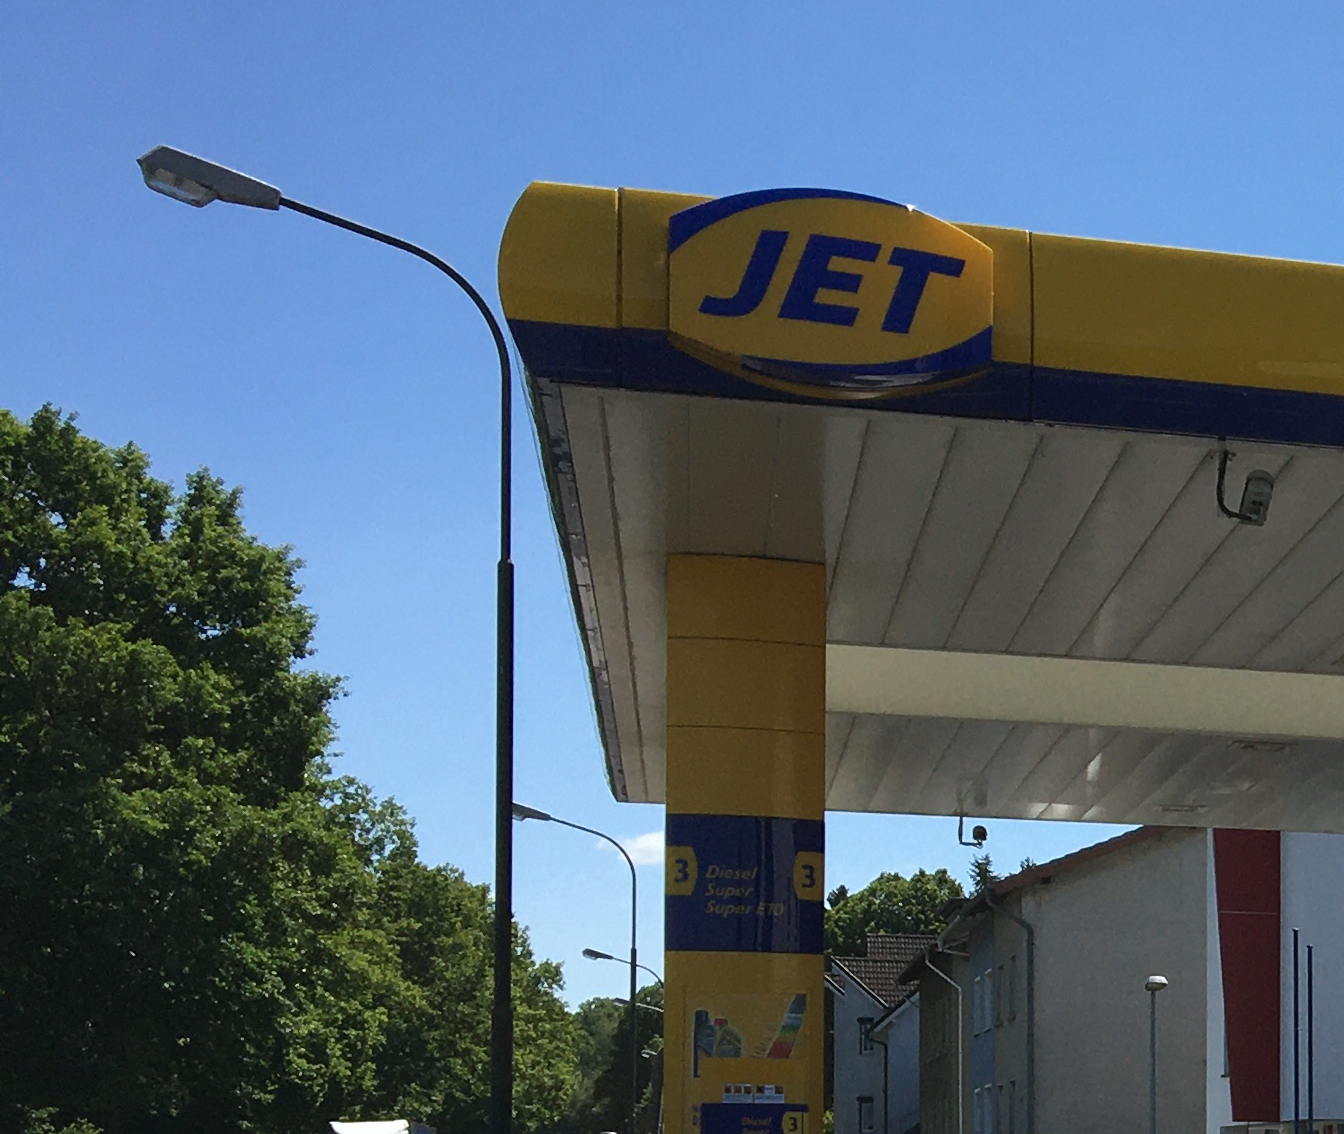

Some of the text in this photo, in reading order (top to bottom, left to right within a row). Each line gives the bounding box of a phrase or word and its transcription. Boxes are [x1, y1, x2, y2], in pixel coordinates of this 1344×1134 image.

[698, 229, 966, 334] JET
[674, 859, 690, 883] 3
[705, 865, 759, 879] Diesel
[801, 864, 816, 888] 3
[705, 883, 754, 898] Super
[705, 901, 784, 917] Super E10
[788, 1116, 798, 1132] 3
